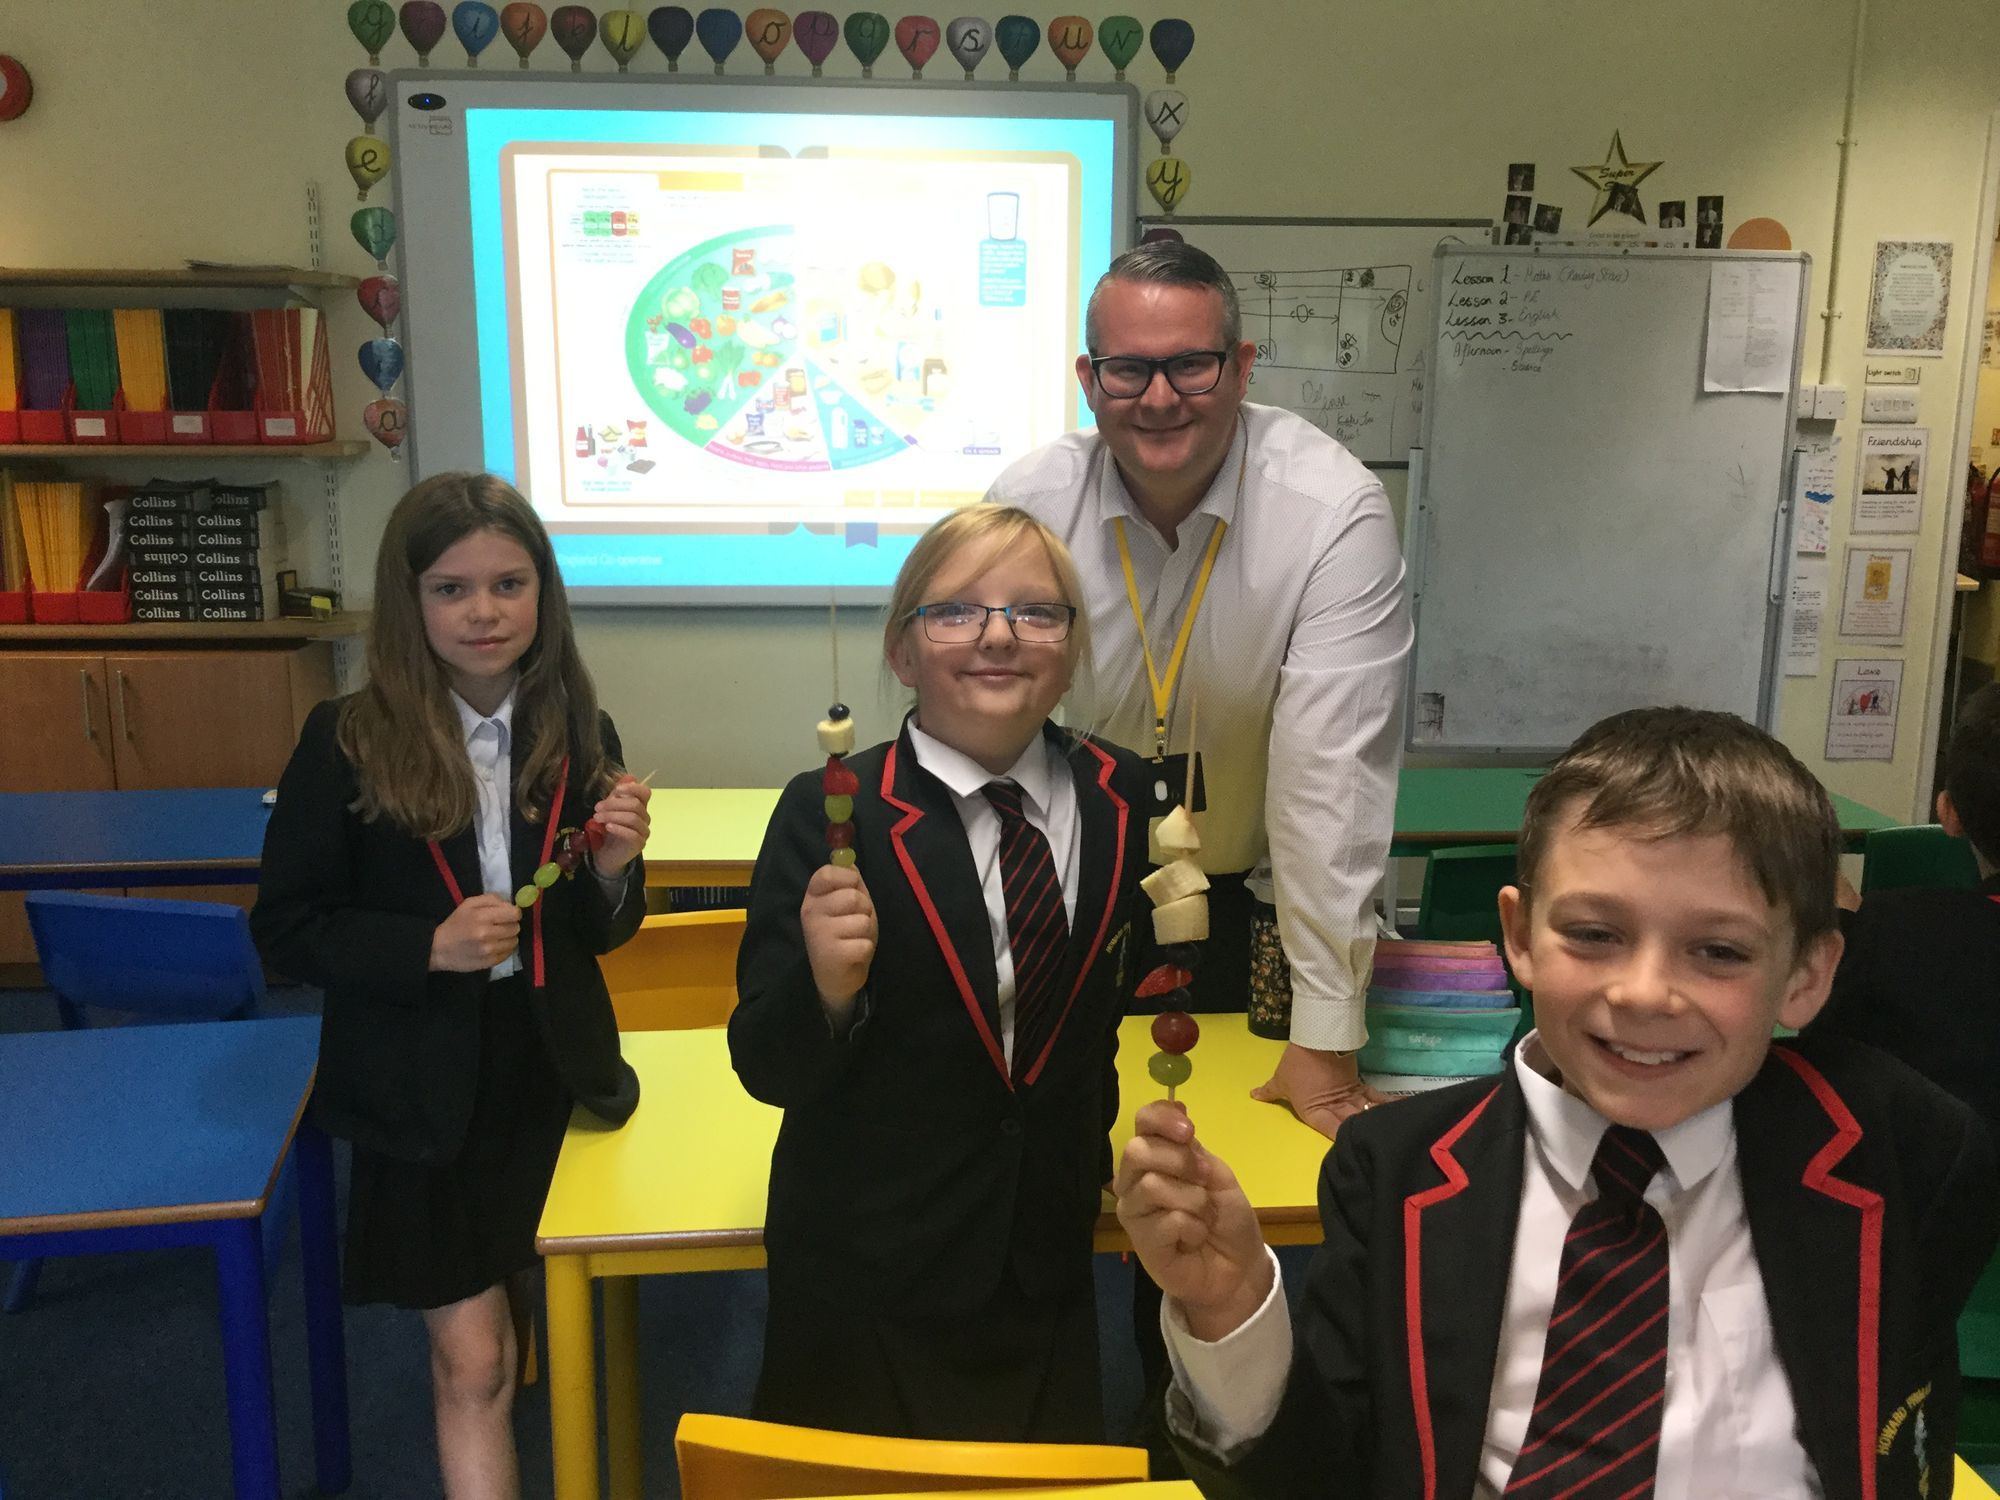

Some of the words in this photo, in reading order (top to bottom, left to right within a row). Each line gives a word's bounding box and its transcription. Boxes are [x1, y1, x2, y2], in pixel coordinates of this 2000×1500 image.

[757, 21, 786, 45] o
[1057, 26, 1089, 50] u
[904, 29, 937, 53] r
[955, 28, 985, 53] s
[1152, 101, 1185, 125] x
[352, 149, 381, 173] e
[1598, 167, 1635, 180] Super
[1152, 161, 1183, 204] y
[1451, 260, 1495, 285] Lesson
[1499, 263, 1512, 285] 1
[1448, 291, 1492, 308] Lesson
[1498, 290, 1508, 306] 2
[1445, 309, 1492, 327] Lesson
[1498, 312, 1508, 325] 3
[380, 410, 405, 432] a
[1867, 435, 1922, 448] Friendship
[132, 496, 177, 508] Collins
[210, 493, 249, 505] ollins
[129, 513, 174, 527] Collins
[197, 514, 242, 527] Collins
[130, 532, 175, 545] Collins
[198, 532, 242, 545] Collins
[143, 552, 188, 565] Collins
[196, 551, 241, 564] Collins
[132, 570, 177, 583] Collins
[199, 570, 243, 582] Collins
[134, 588, 179, 601] Collins
[201, 588, 246, 601] Collins
[136, 606, 181, 619] Collins
[203, 606, 247, 619] Collins
